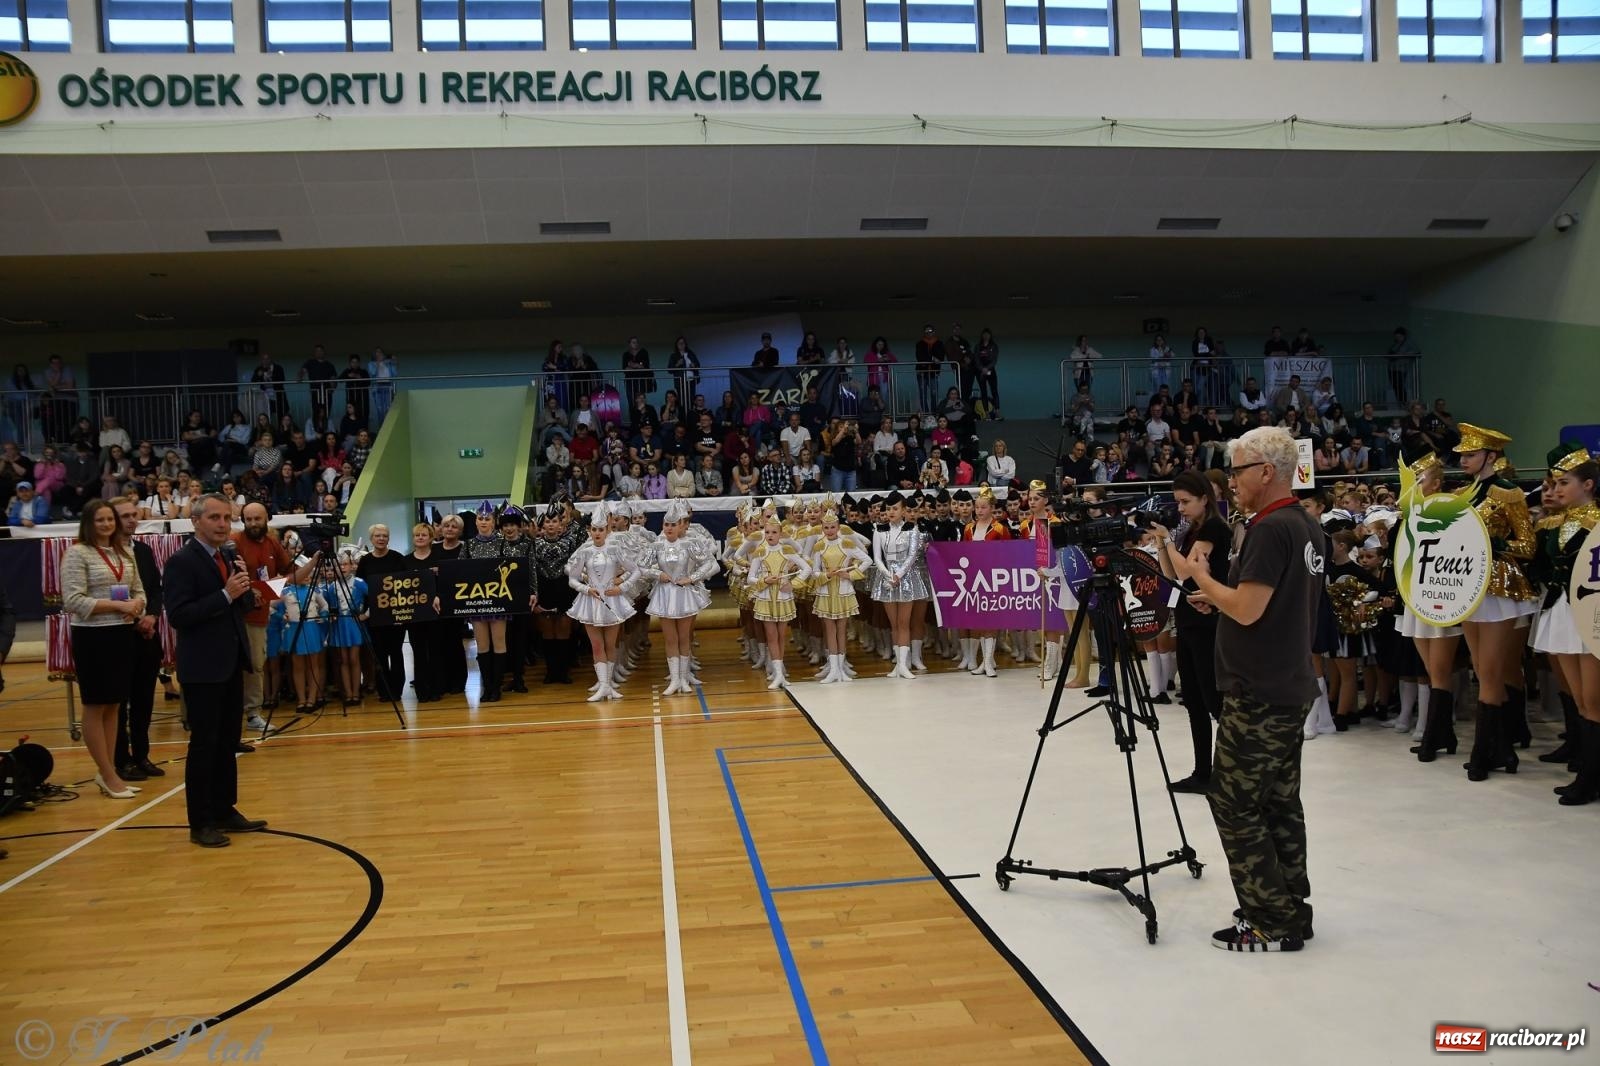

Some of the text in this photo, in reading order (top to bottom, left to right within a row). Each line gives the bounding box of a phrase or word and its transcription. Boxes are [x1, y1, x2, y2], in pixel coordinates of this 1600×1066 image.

[58, 64, 821, 108] OŚRODEK SPORTU I REKREACJI RACIBÓRZ
[1418, 537, 1474, 585] Fenix
[382, 576, 421, 594] Spec
[454, 573, 514, 601] ZARA
[1429, 576, 1464, 588] RADLIN
[377, 592, 428, 608] Babcie
[1422, 590, 1456, 601] POLAND
[1415, 603, 1446, 620] TANECZNY
[1451, 605, 1467, 618] KLUB
